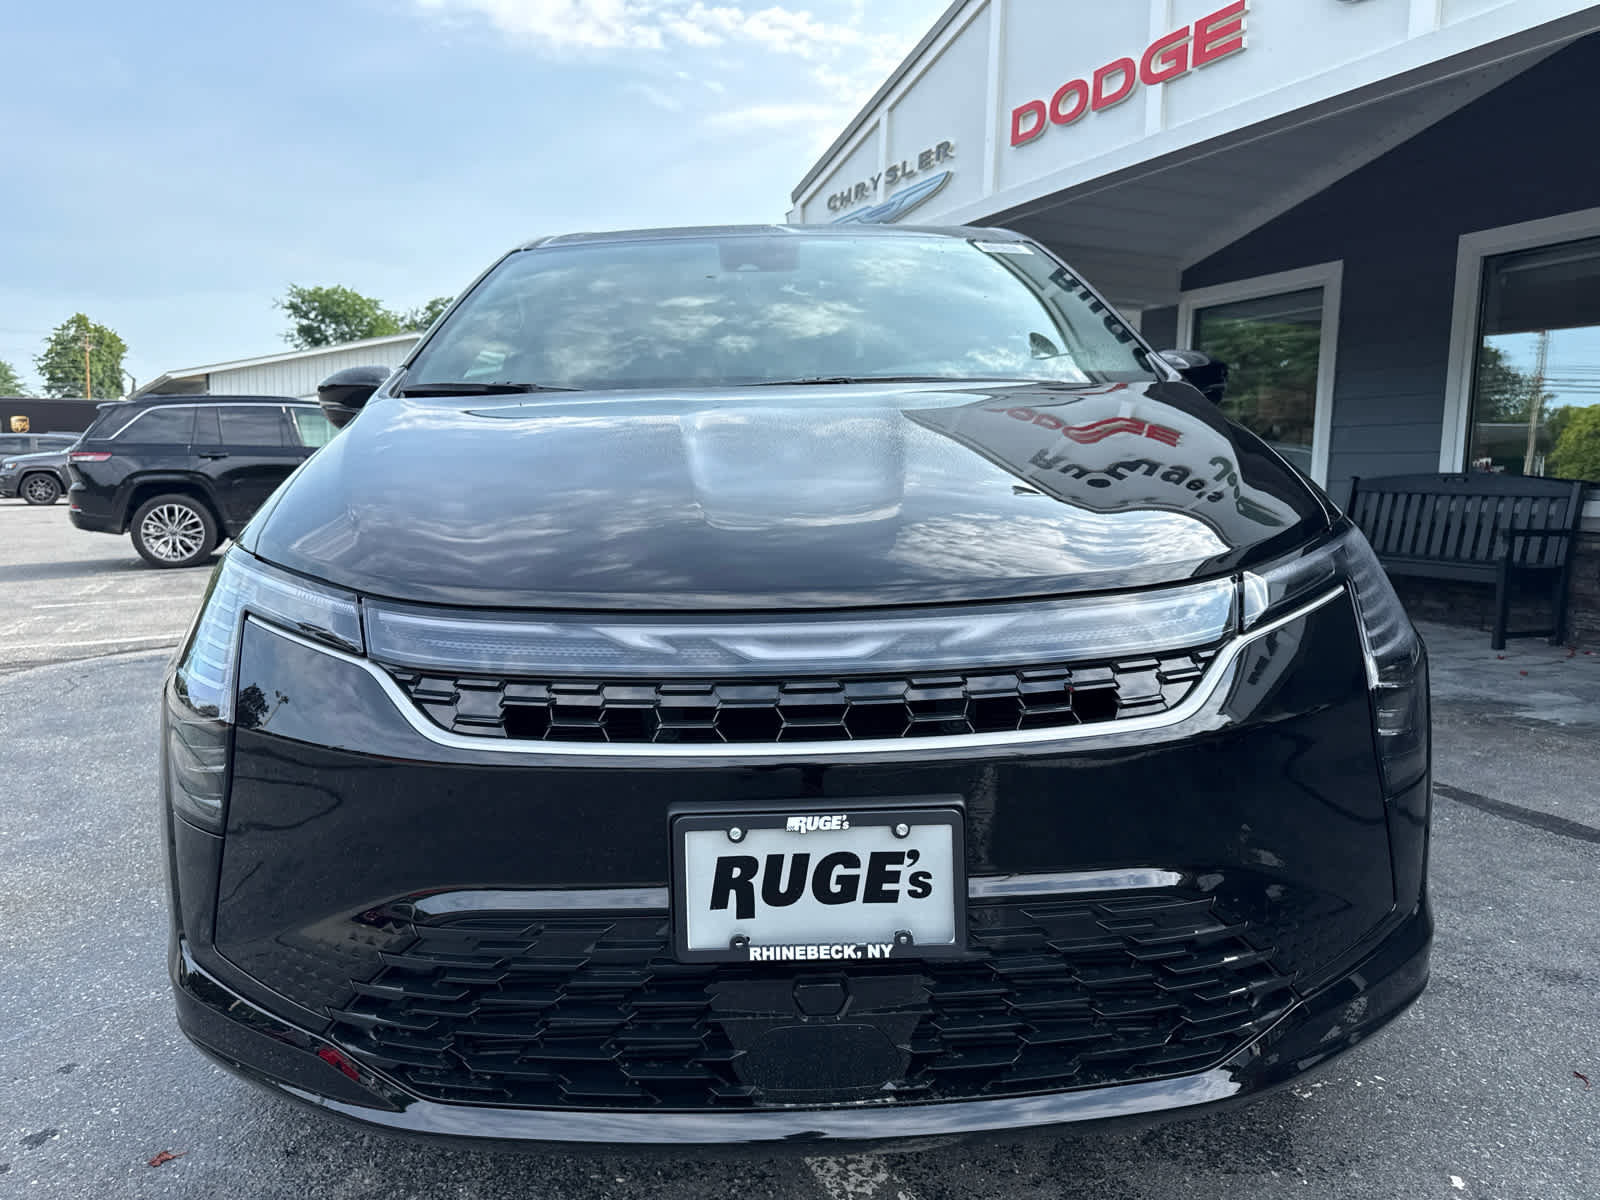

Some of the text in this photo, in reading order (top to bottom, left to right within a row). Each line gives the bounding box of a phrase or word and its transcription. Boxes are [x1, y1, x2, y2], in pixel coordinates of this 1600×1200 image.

[1011, 0, 1248, 146] DODGE
[827, 141, 953, 211] CHRYSLER
[787, 814, 849, 834] RUGE's
[709, 849, 932, 920] RUGE's
[750, 944, 894, 961] RHINEBECK, NY
